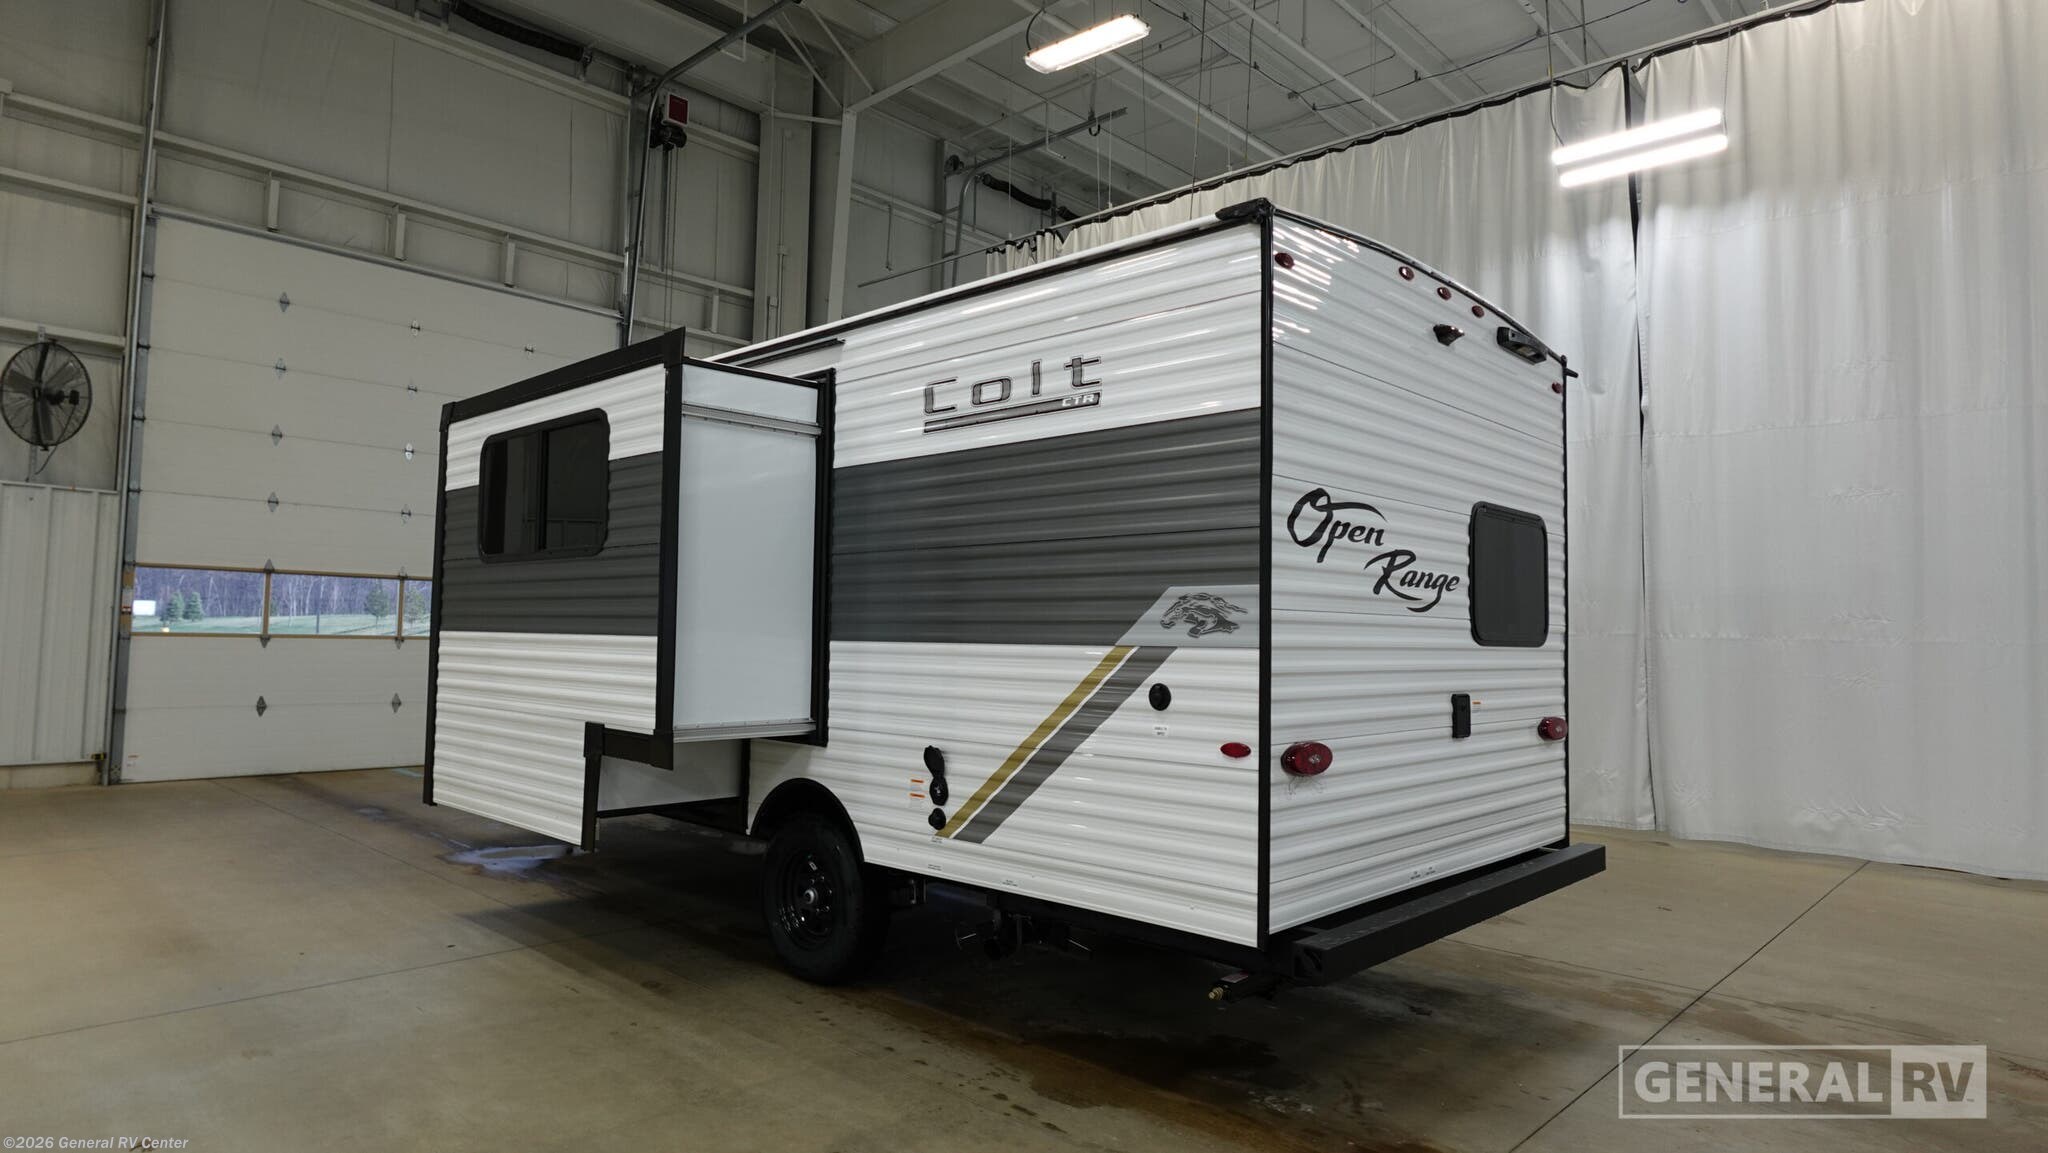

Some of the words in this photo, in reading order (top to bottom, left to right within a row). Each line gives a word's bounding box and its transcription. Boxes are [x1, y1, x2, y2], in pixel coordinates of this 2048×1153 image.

[923, 355, 1102, 415] Colt
[1061, 393, 1095, 407] CTR
[1286, 487, 1387, 564] Open
[1363, 549, 1461, 613] Range
